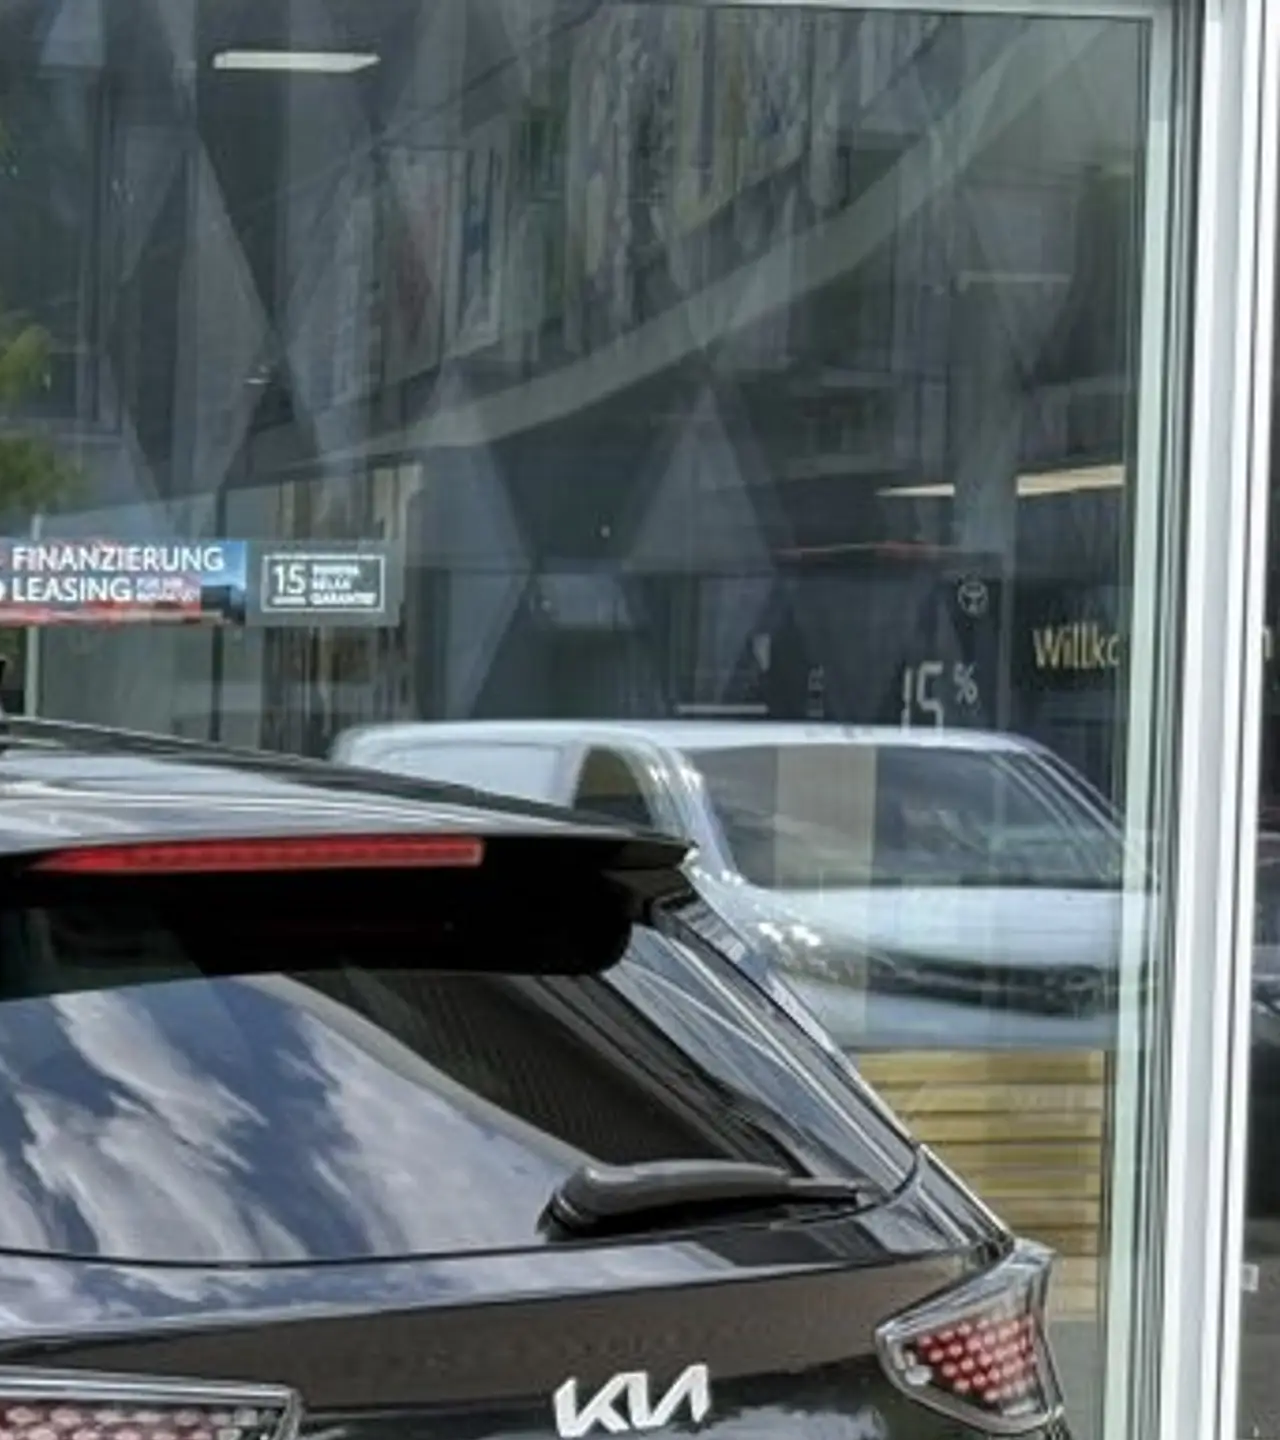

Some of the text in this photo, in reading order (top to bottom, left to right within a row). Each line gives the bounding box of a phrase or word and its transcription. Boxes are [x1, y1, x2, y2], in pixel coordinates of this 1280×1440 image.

[12, 546, 225, 572] FINANZIERUNG
[12, 577, 131, 602] LEASING
[274, 563, 307, 594] 15
